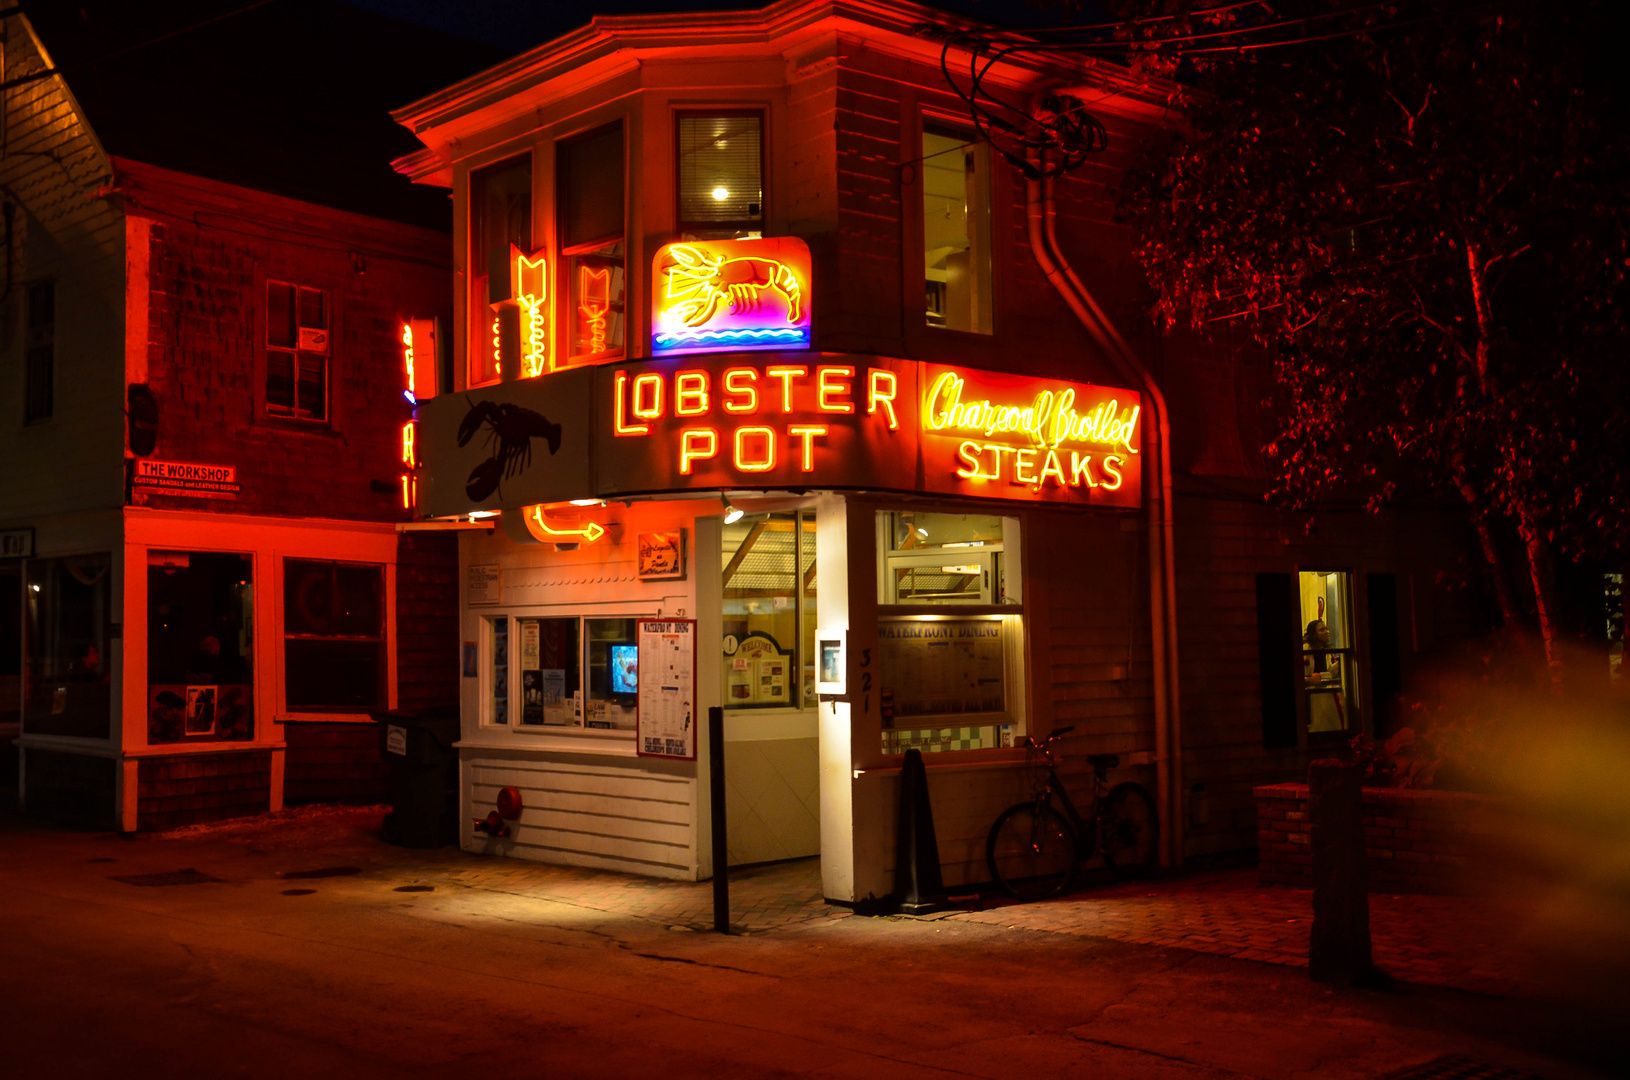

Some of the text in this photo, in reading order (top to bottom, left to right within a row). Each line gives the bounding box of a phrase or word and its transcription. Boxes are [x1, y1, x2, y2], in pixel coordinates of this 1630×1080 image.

[615, 366, 899, 436] LOBSTER
[929, 372, 1141, 454] Charcoal Broiled
[680, 425, 828, 474] POT
[956, 441, 1124, 491] STEAKS
[134, 476, 158, 485] CUSTOM
[158, 478, 184, 488] SANDALS
[195, 481, 219, 490] LEATHER
[220, 484, 240, 492] DESIGN
[142, 462, 230, 481] THE WORKSHOP
[741, 639, 772, 654] WELCOME
[878, 623, 999, 639] WATERFRONT DINING
